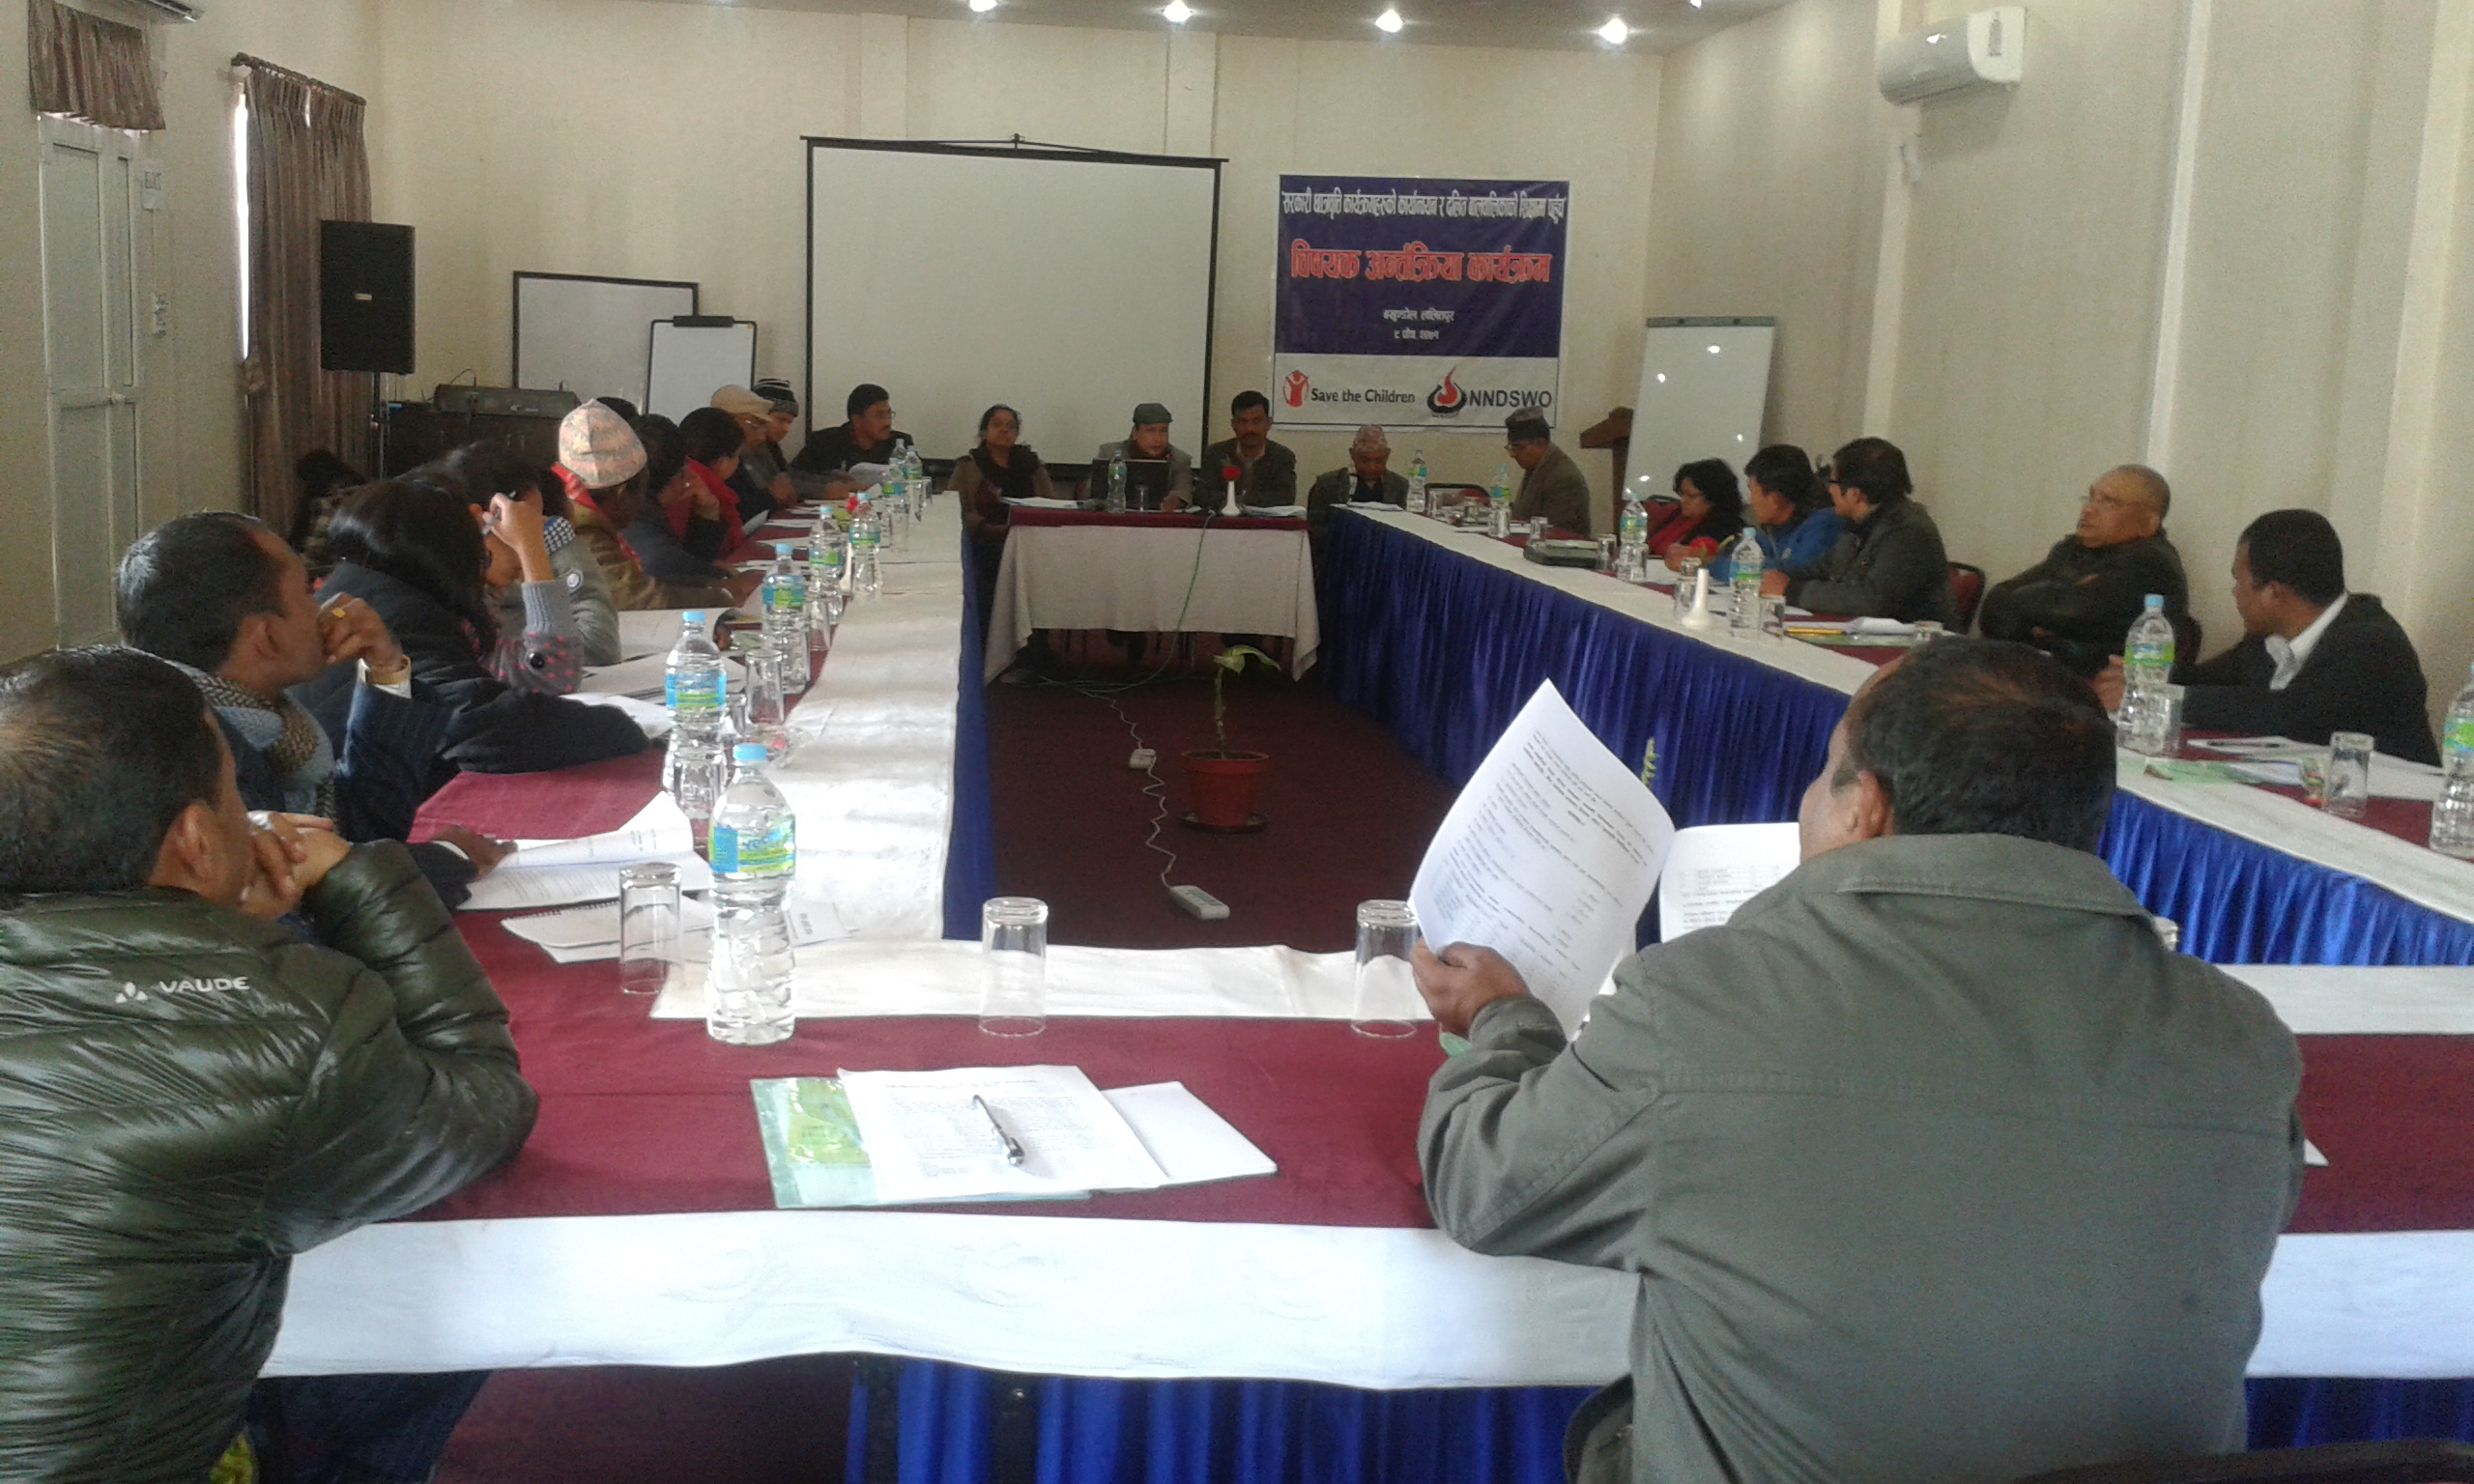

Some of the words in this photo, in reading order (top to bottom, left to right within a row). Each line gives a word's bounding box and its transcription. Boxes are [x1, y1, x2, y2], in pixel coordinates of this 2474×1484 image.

[1291, 239, 1362, 278] विषयक
[1467, 245, 1552, 284] कार्यक्रम
[1310, 387, 1339, 402] Save
[1342, 389, 1362, 402] the
[1365, 389, 1416, 404] Children
[1470, 389, 1552, 408] NNDSWO
[158, 976, 250, 993] VAUDE
